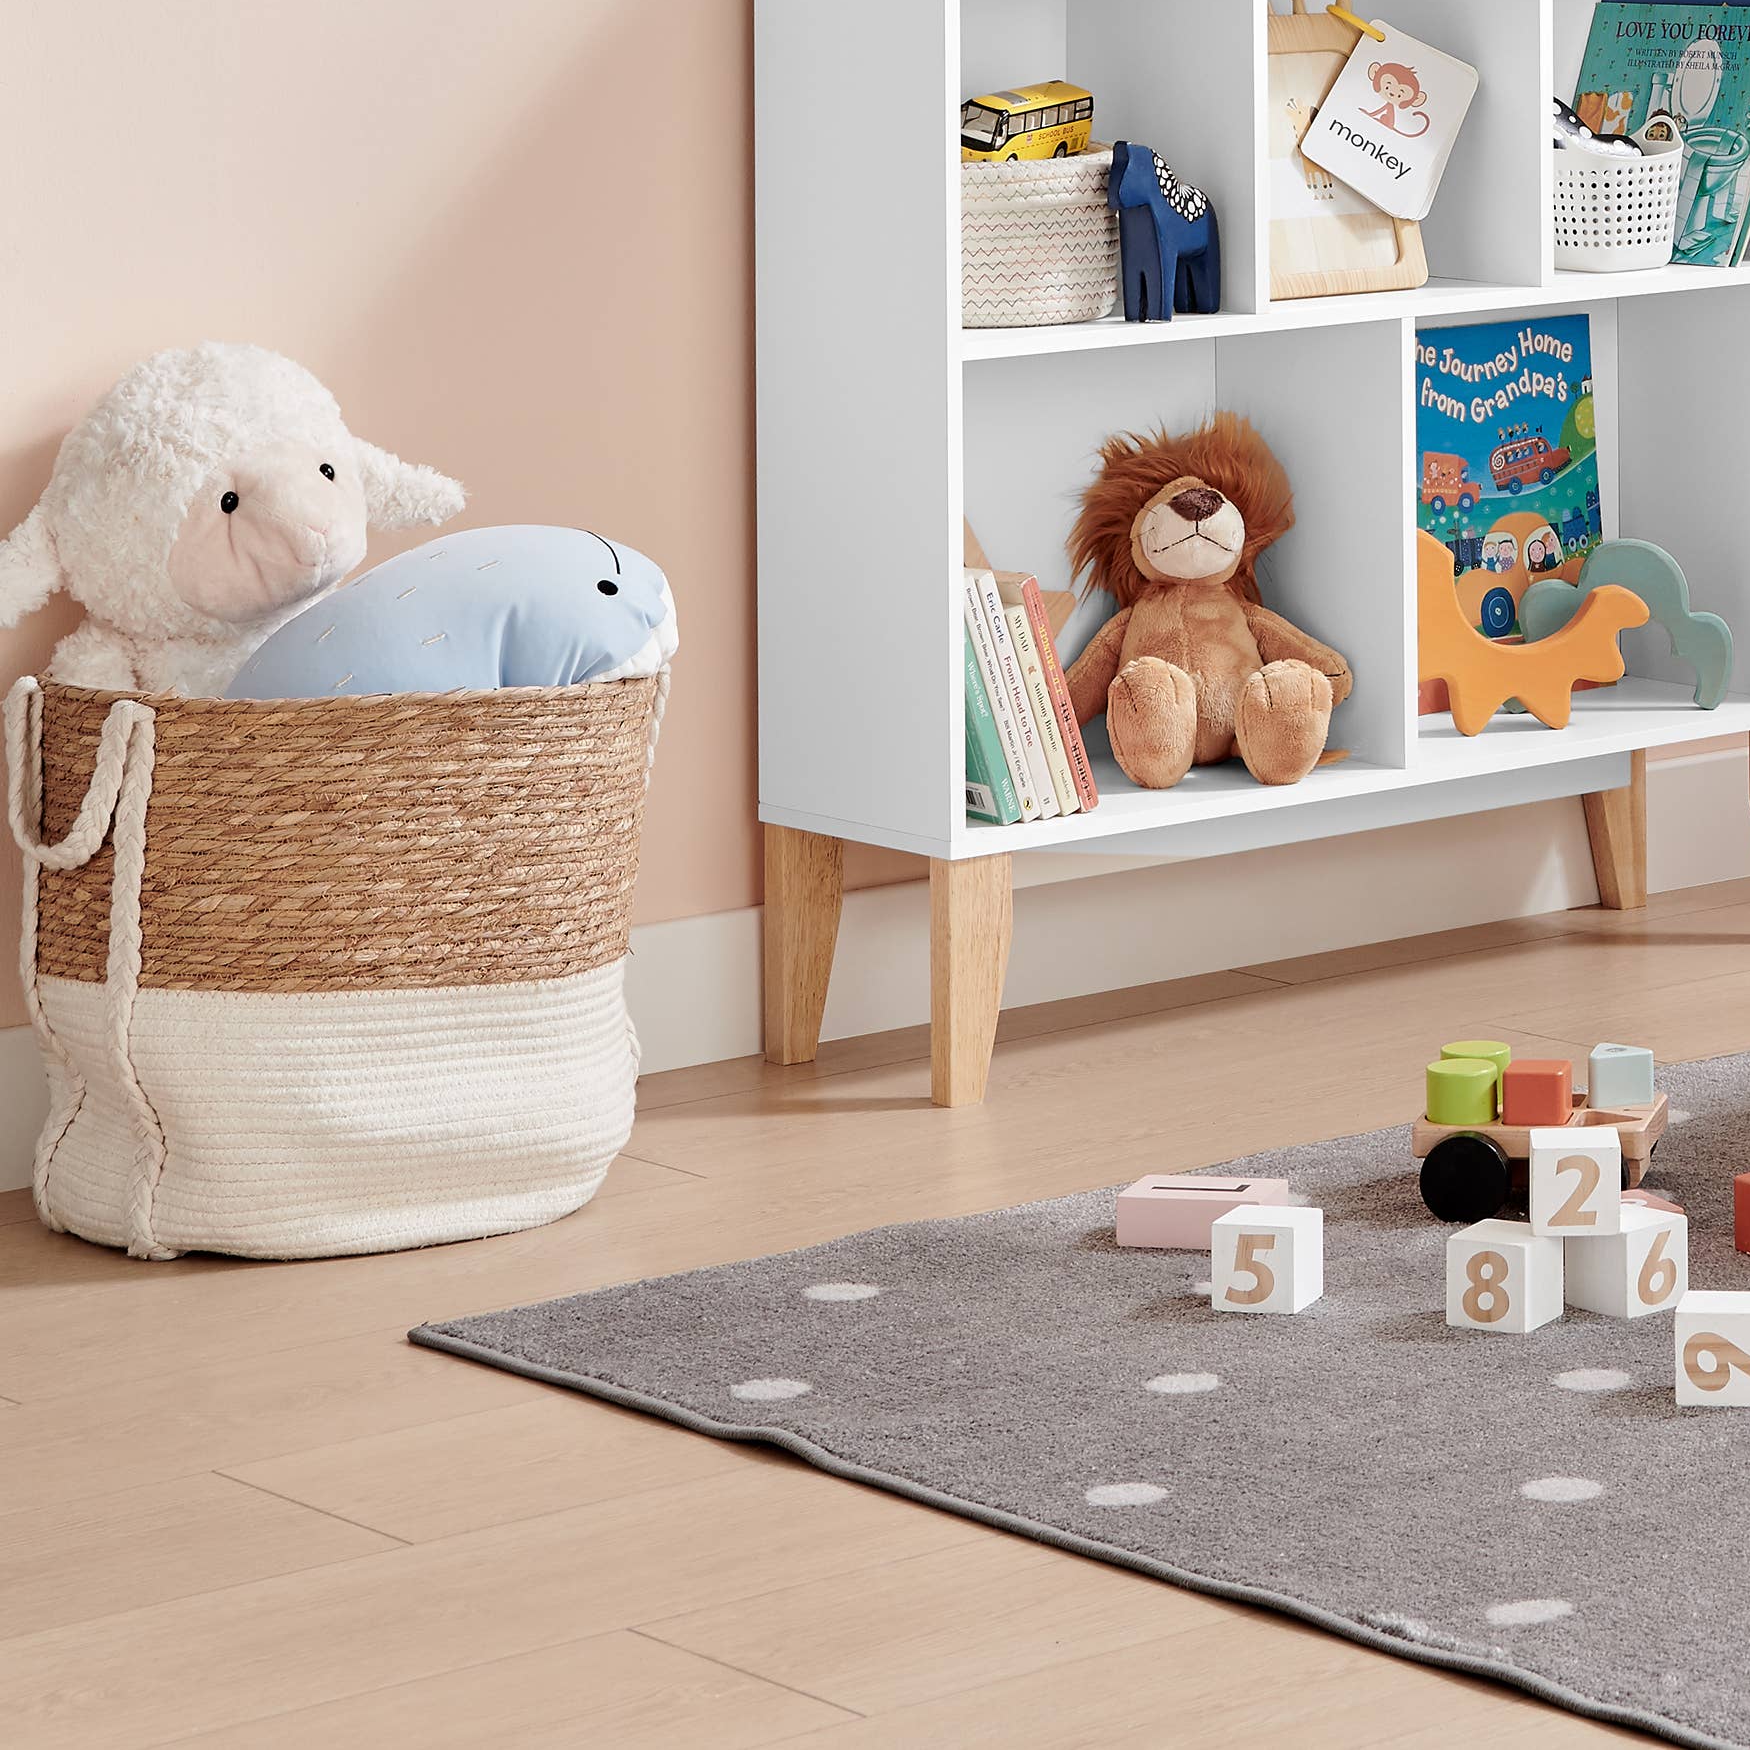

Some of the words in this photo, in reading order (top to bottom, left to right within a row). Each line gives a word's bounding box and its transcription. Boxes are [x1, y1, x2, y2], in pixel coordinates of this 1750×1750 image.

[1615, 21, 1657, 40] LOVE
[1660, 21, 1694, 41] YOU
[1668, 50, 1678, 58] BY
[1328, 117, 1412, 181] monkey
[1415, 337, 1437, 367] he
[1439, 346, 1518, 383] Journey
[1518, 327, 1573, 363] Home
[1420, 377, 1466, 423] from
[1470, 367, 1568, 424] Grandpa's
[986, 591, 997, 614] Eric
[992, 614, 1005, 645] Carle
[1013, 614, 1024, 630] MY
[1018, 631, 1030, 653] DAD
[1003, 655, 1016, 685] From
[1011, 686, 1027, 715] Head
[1034, 681, 1048, 718] Anthony
[1020, 716, 1029, 728] to
[1023, 727, 1034, 749] Toe
[1547, 1154, 1602, 1227] 2
[1223, 1233, 1276, 1305] 5
[1637, 1228, 1678, 1306] 6
[1461, 1250, 1511, 1324] 8
